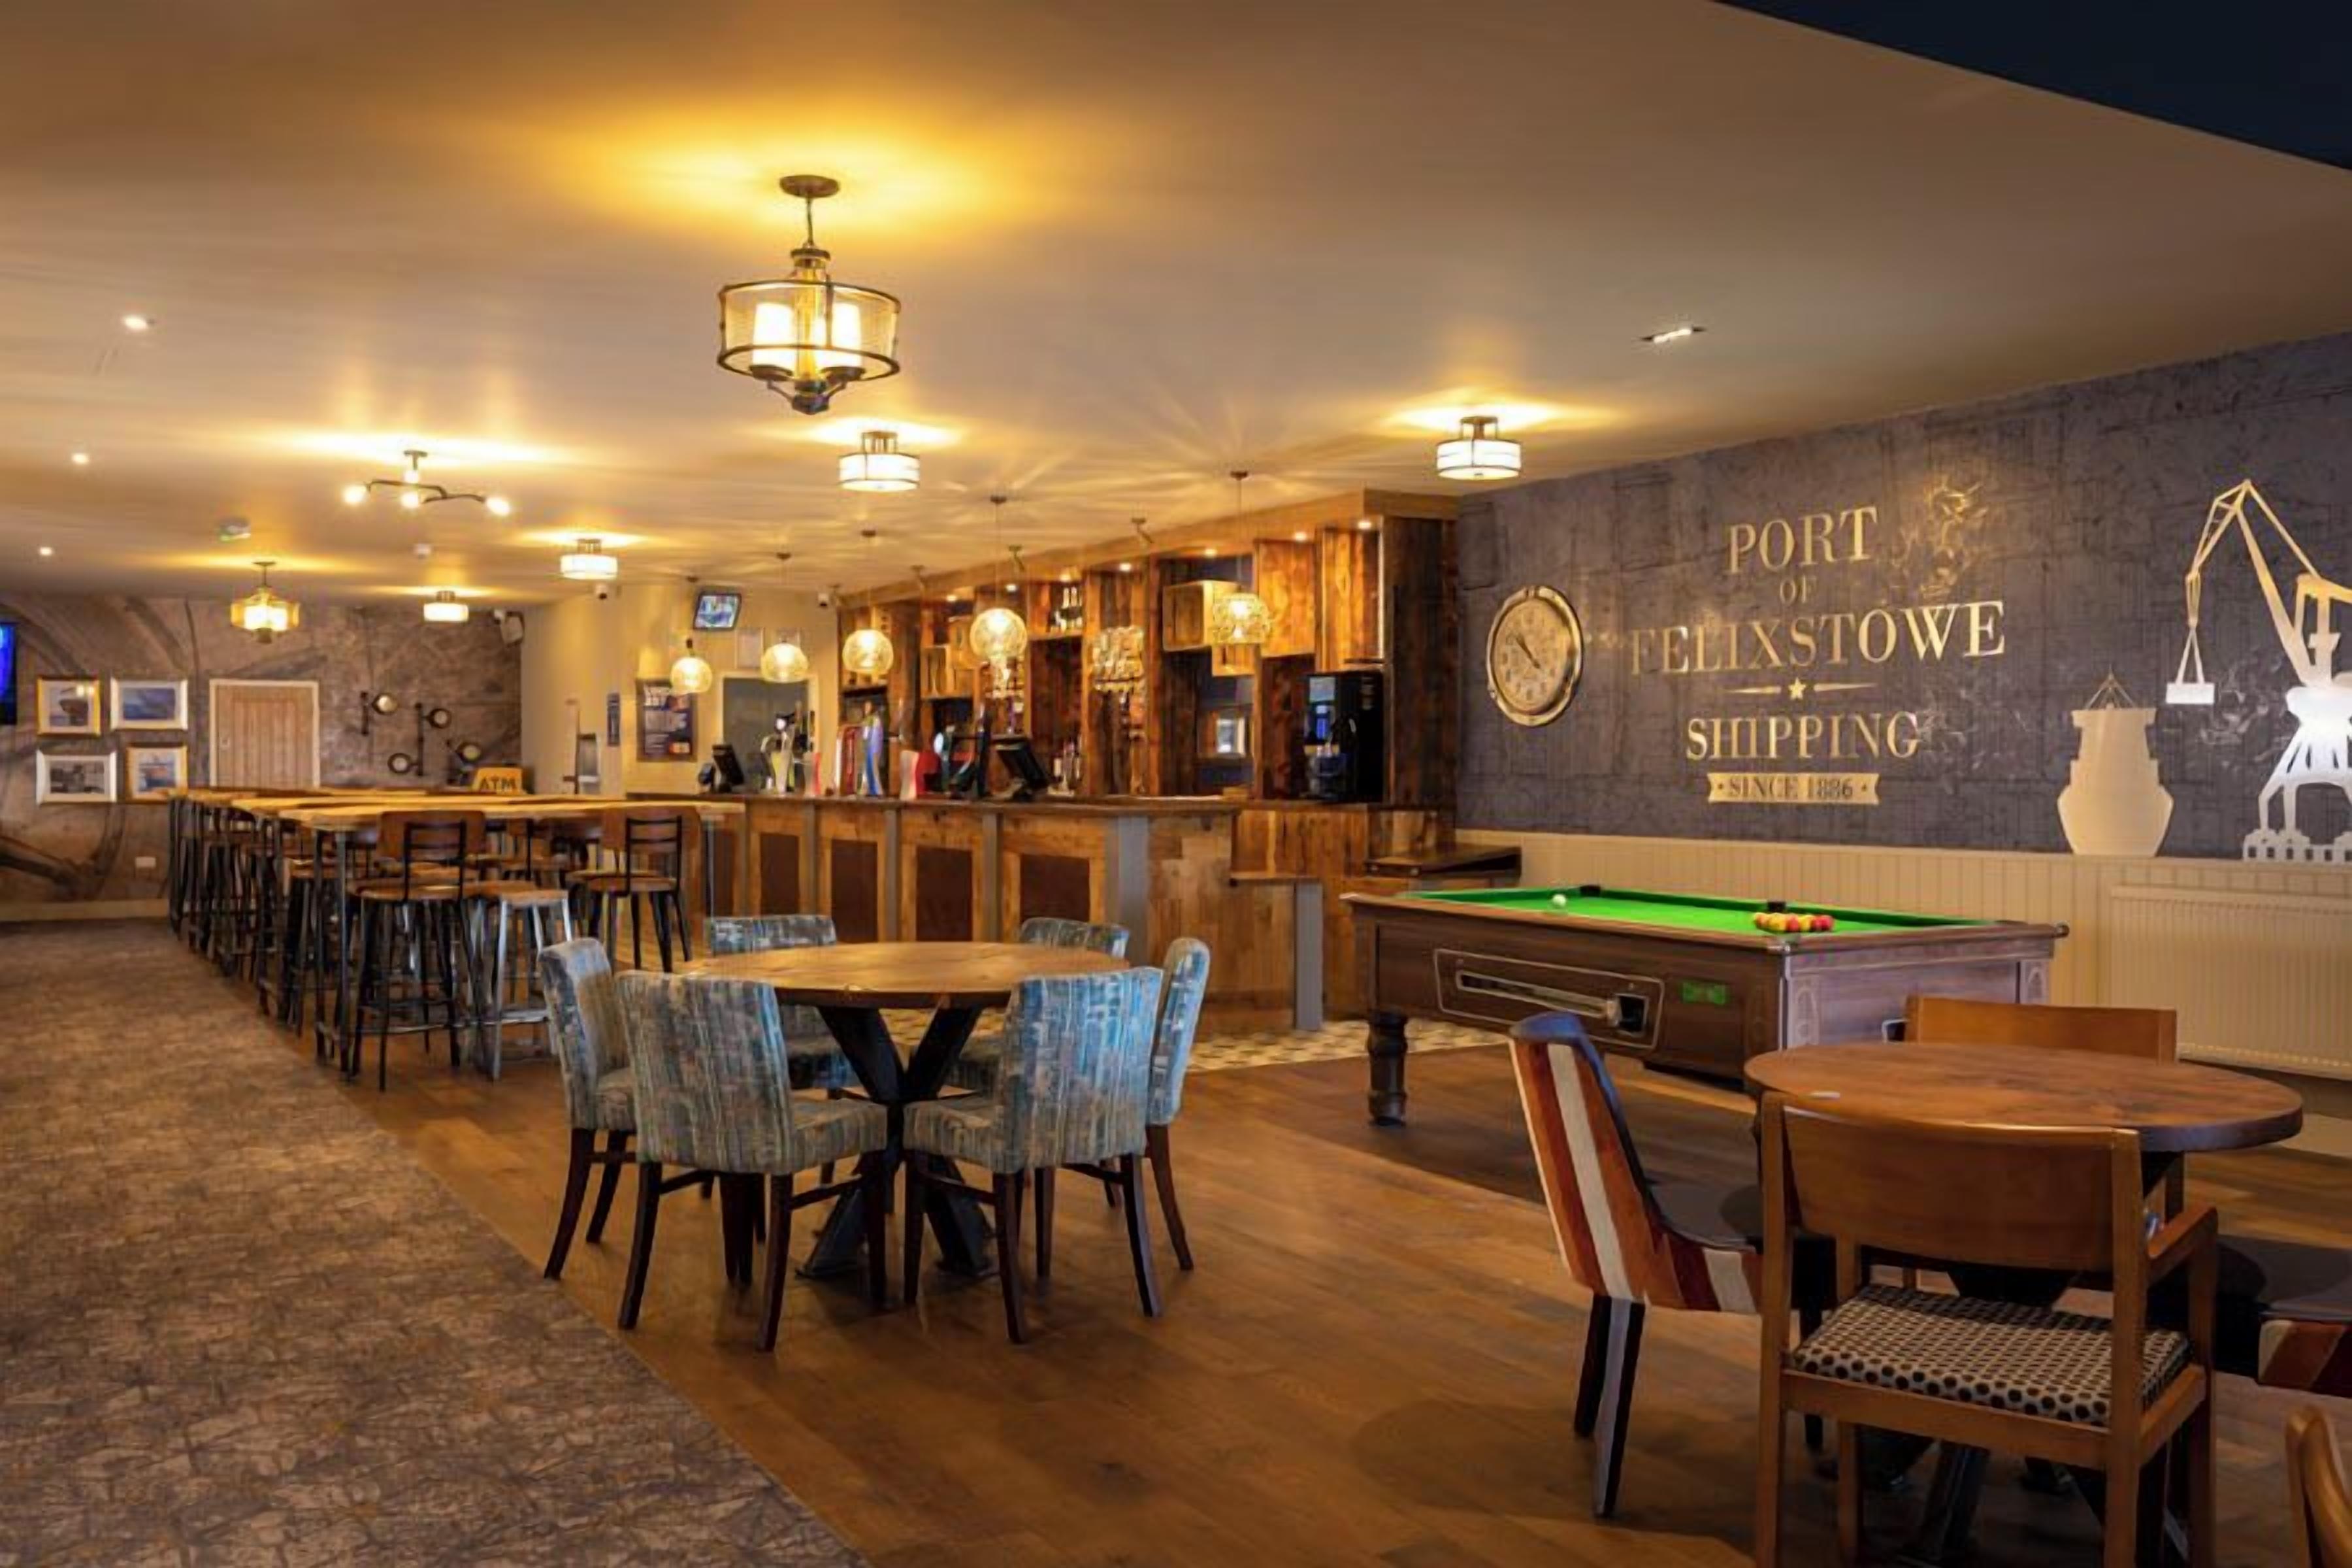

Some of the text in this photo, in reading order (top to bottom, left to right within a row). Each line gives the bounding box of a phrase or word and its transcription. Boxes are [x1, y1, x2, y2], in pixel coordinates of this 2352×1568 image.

[1723, 506, 1878, 574] PORT
[1779, 574, 1817, 605] OF
[1631, 600, 2005, 676] FELIXSTOWE
[1686, 711, 1919, 760] SHIPPING
[478, 776, 517, 791] ATM
[1729, 776, 1798, 798] SINCE
